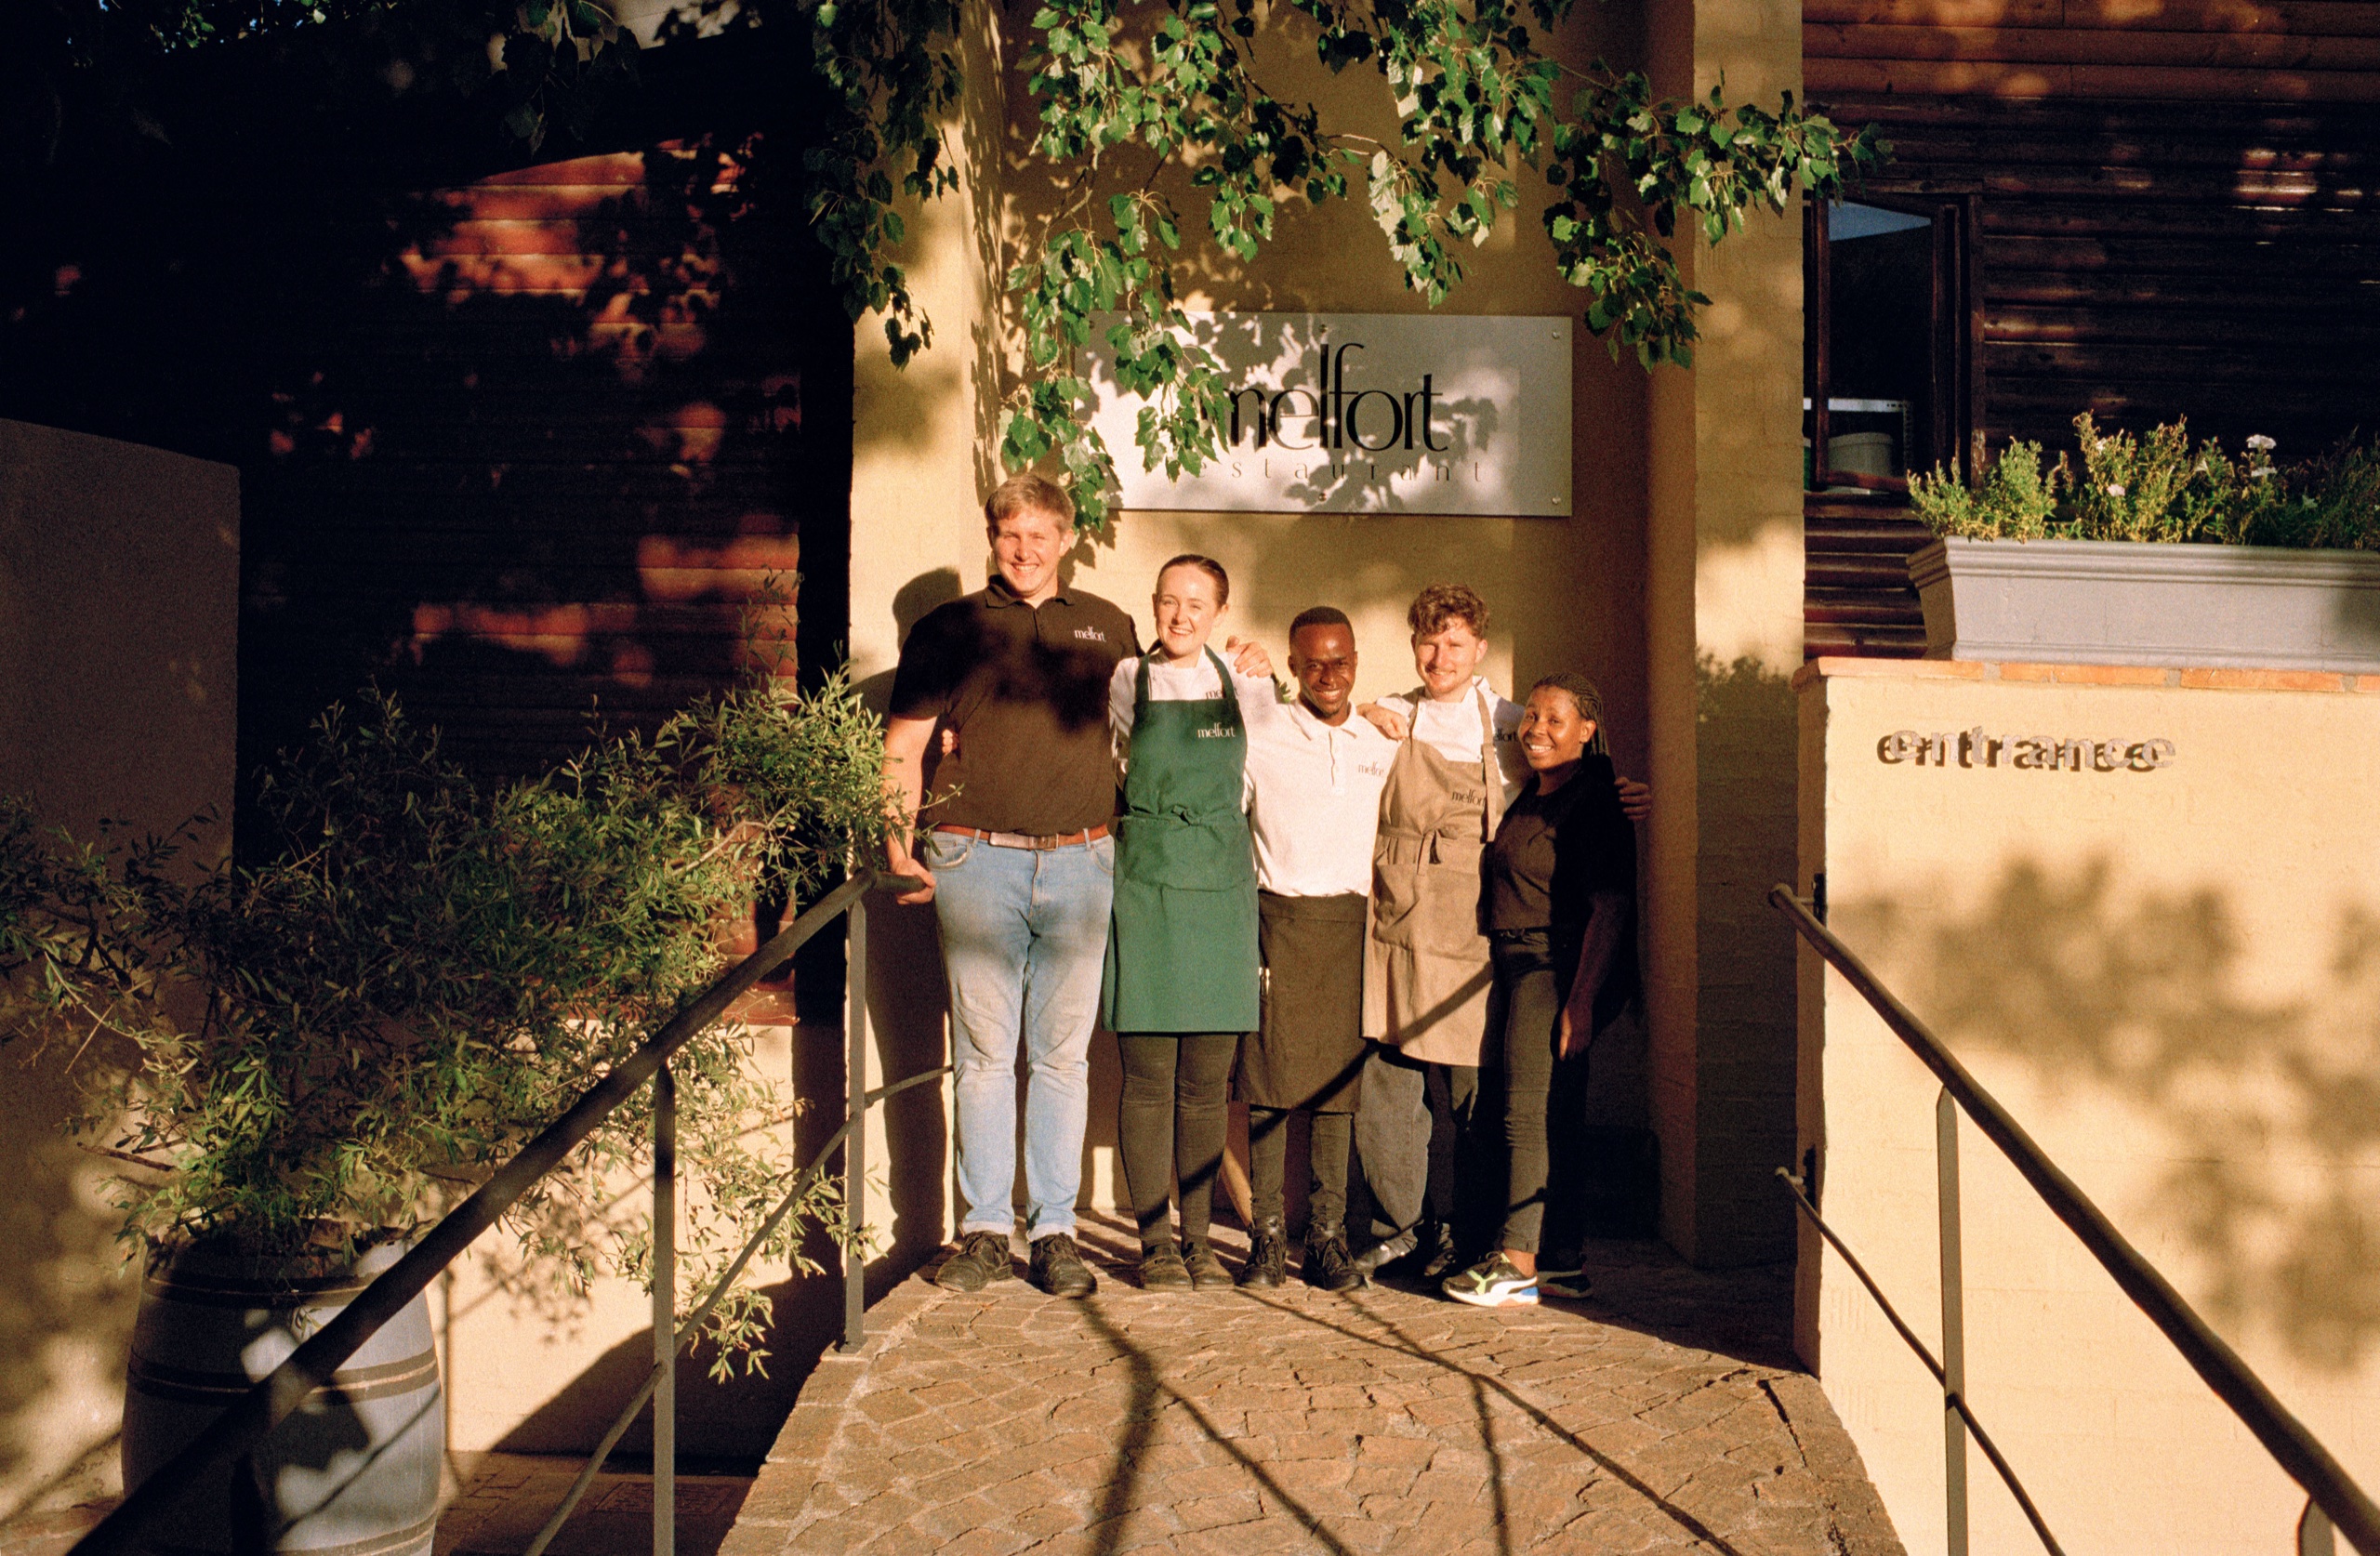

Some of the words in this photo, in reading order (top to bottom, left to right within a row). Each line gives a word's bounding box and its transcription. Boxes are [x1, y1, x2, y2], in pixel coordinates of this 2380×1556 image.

[1074, 626, 1106, 642] melfort
[1197, 721, 1236, 739] melfort
[1889, 725, 2176, 769] entrance
